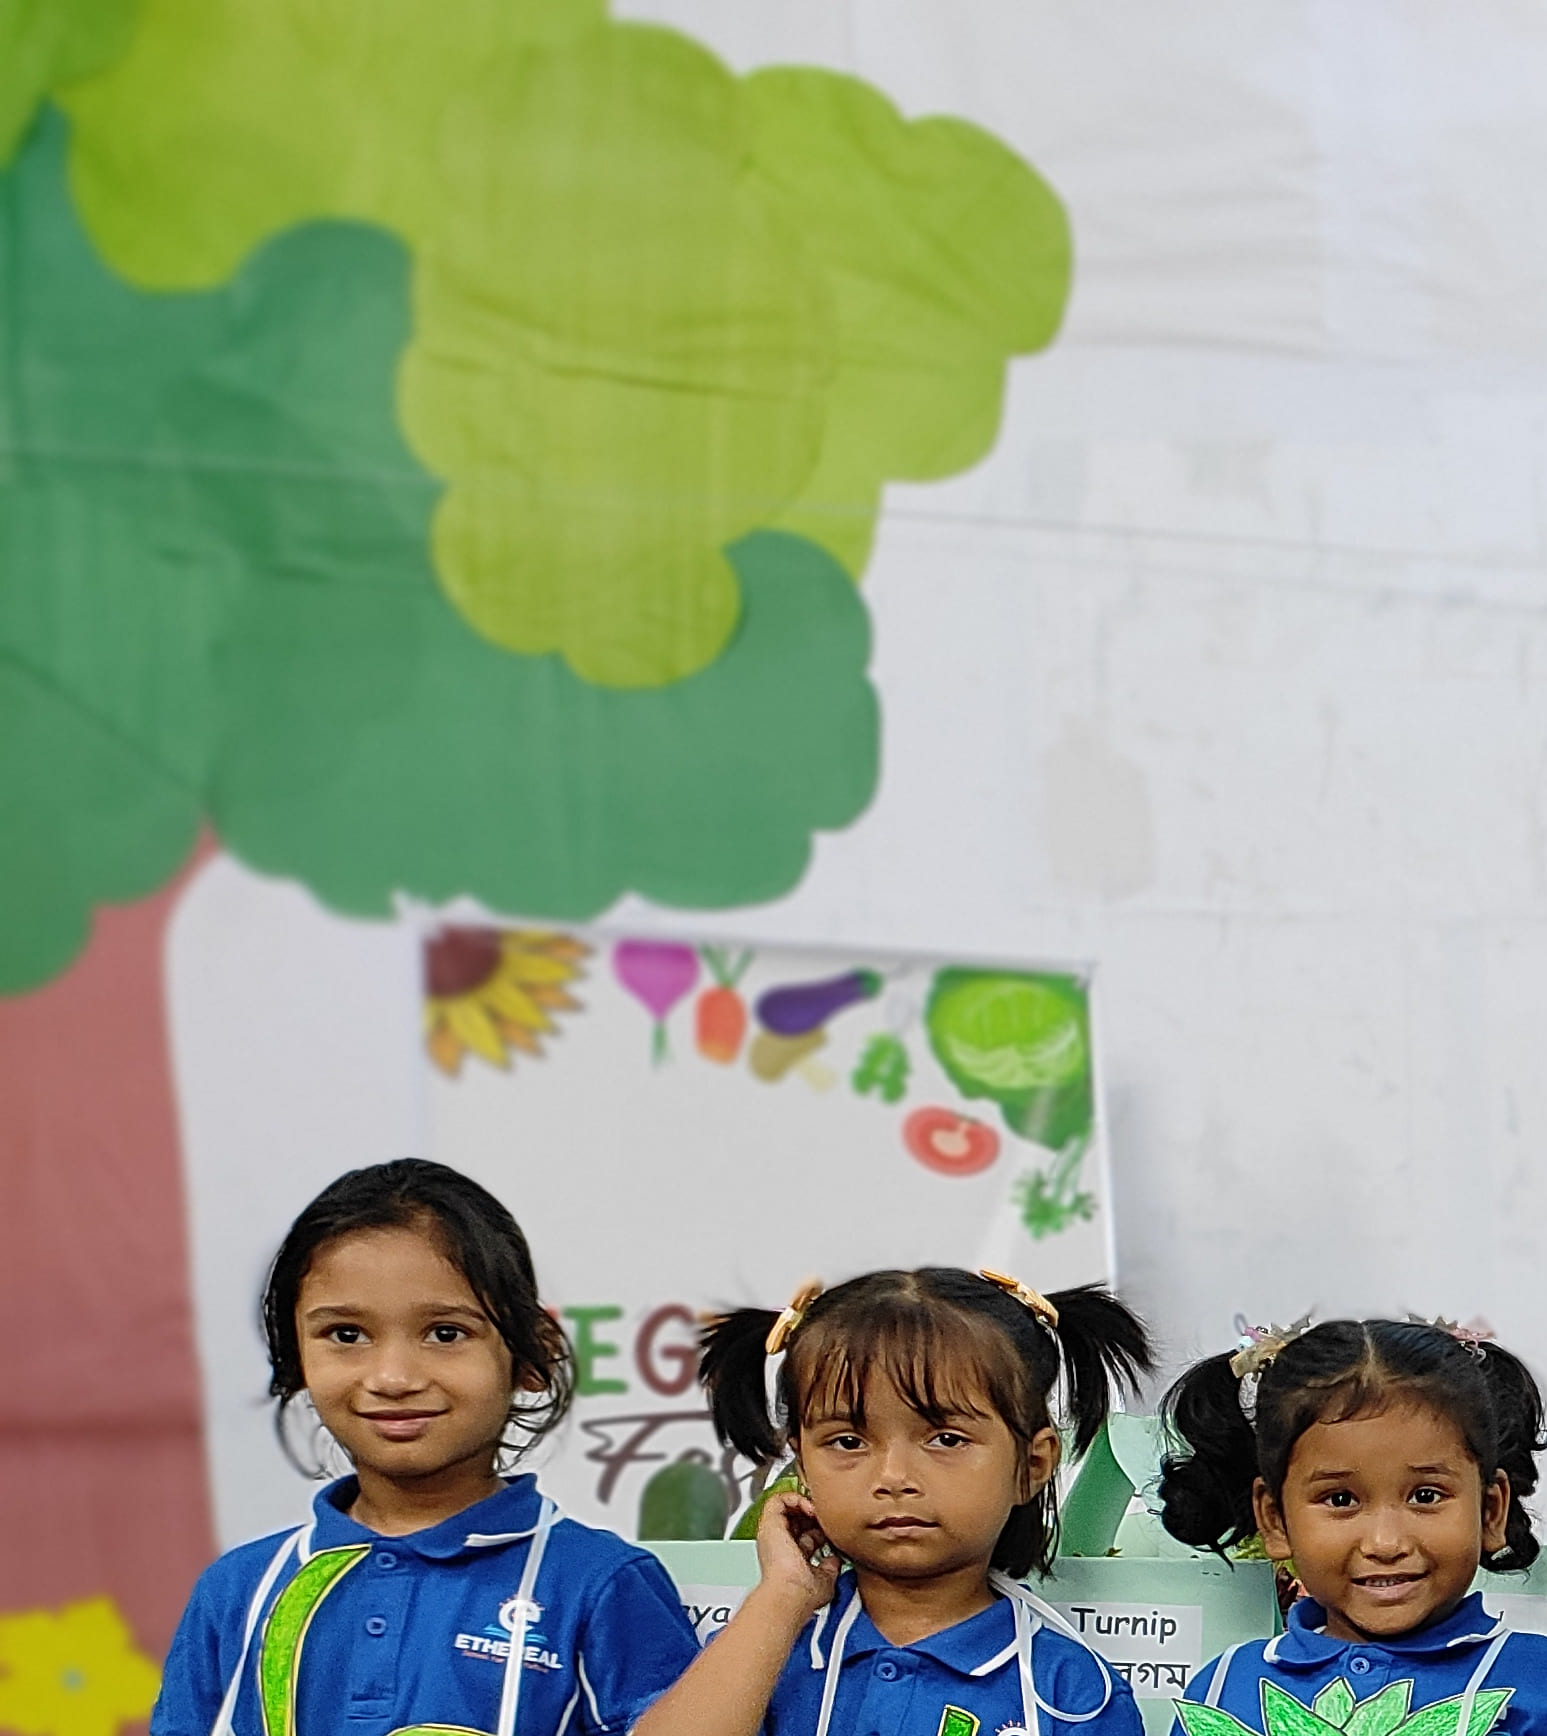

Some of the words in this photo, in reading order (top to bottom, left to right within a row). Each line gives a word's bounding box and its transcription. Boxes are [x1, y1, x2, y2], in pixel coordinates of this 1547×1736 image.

[552, 1303, 712, 1396] EG
[1071, 1607, 1177, 1644] Turnip
[454, 1633, 564, 1669] ETHEEAL
